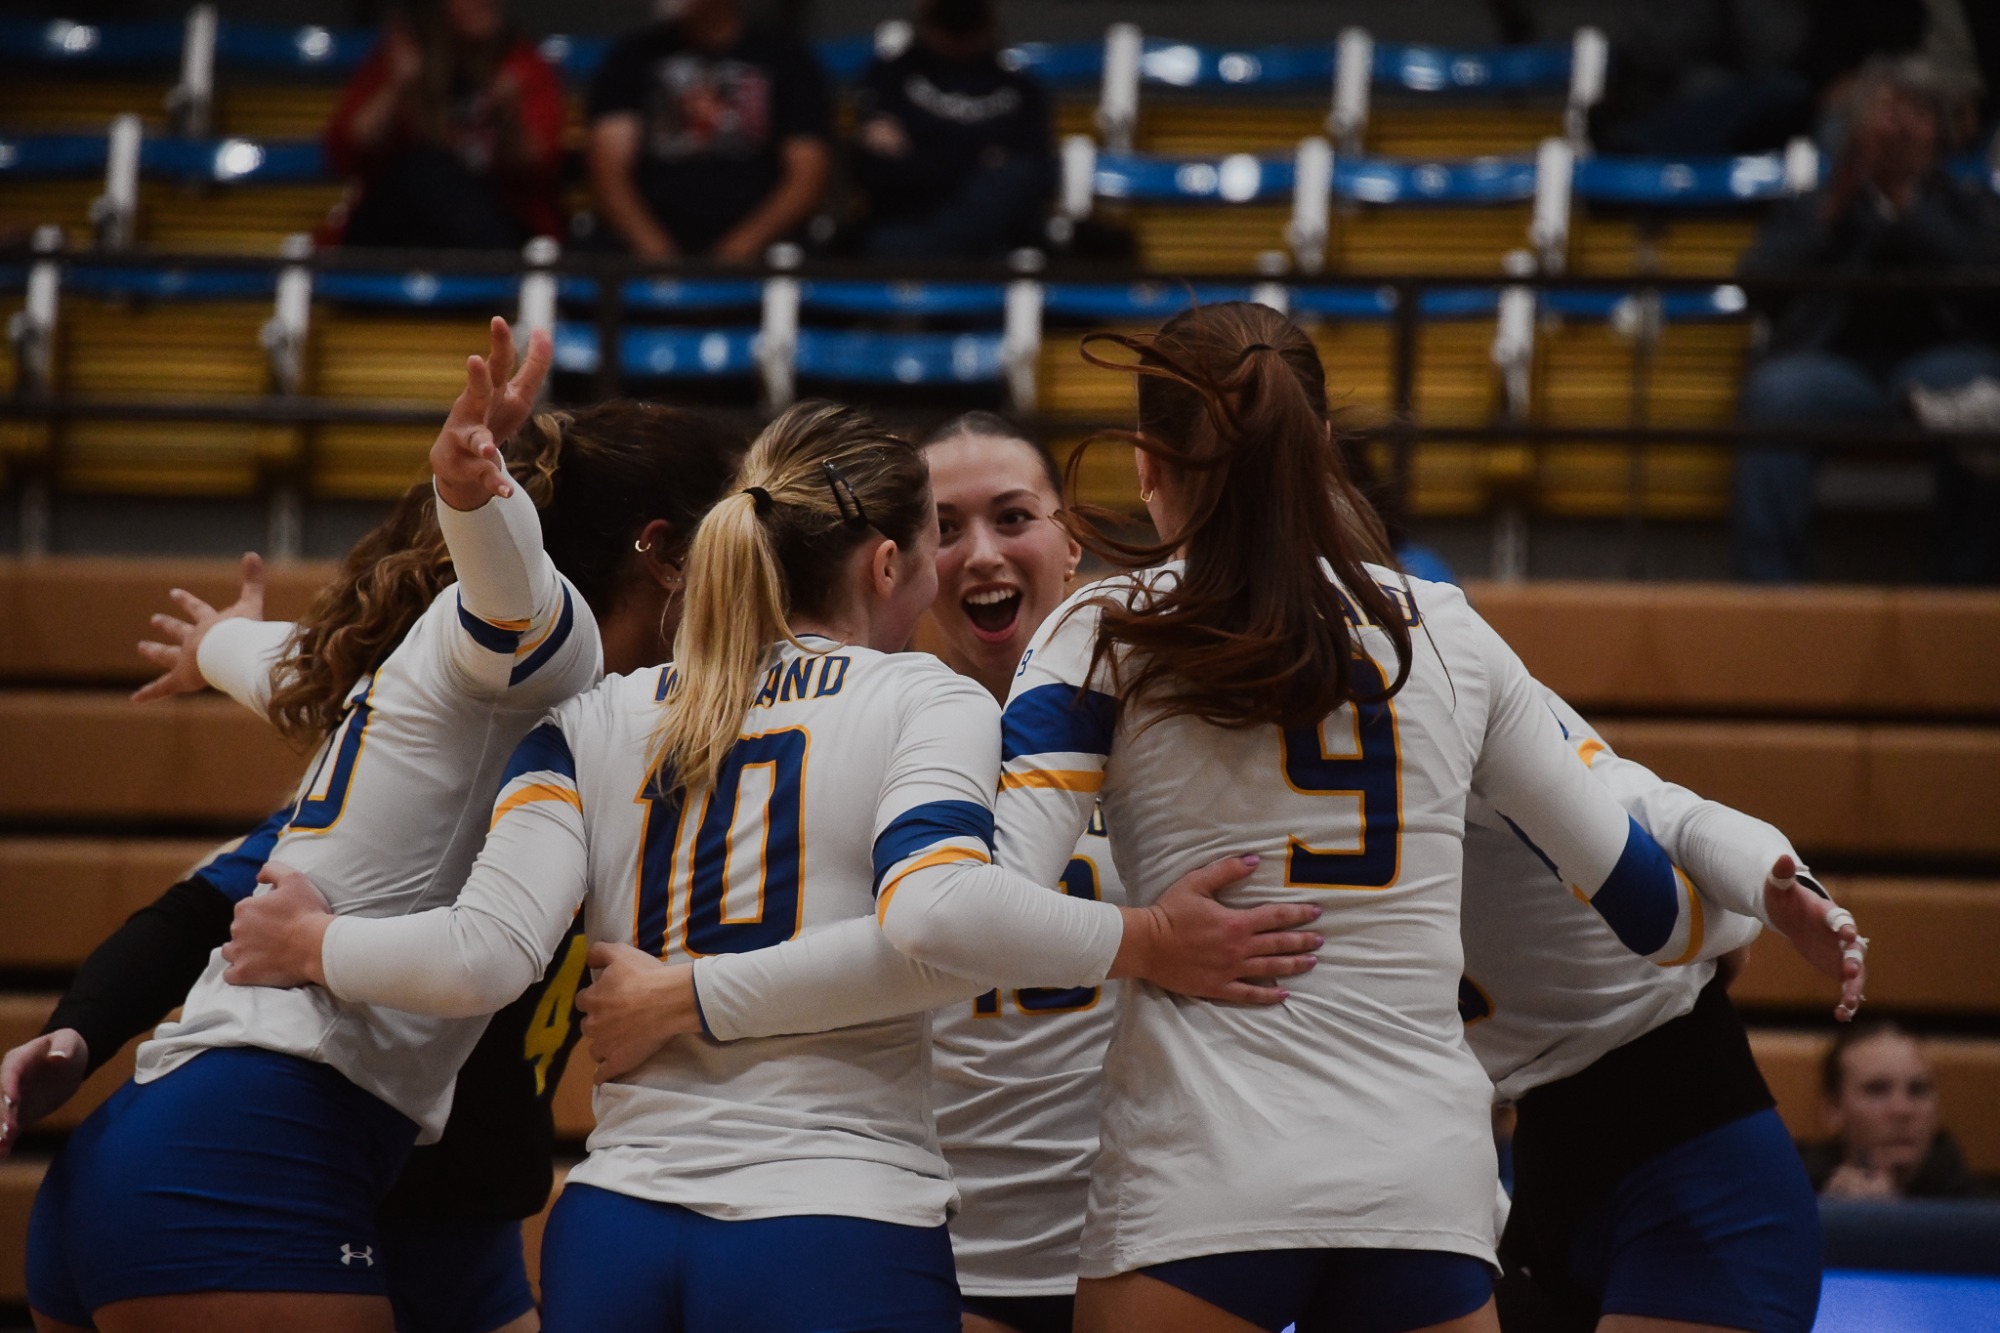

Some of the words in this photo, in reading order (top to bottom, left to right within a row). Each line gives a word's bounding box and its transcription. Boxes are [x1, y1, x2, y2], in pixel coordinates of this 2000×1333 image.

[1016, 648, 1034, 677] 9
[1278, 653, 1403, 890] 9
[633, 724, 811, 962] 10
